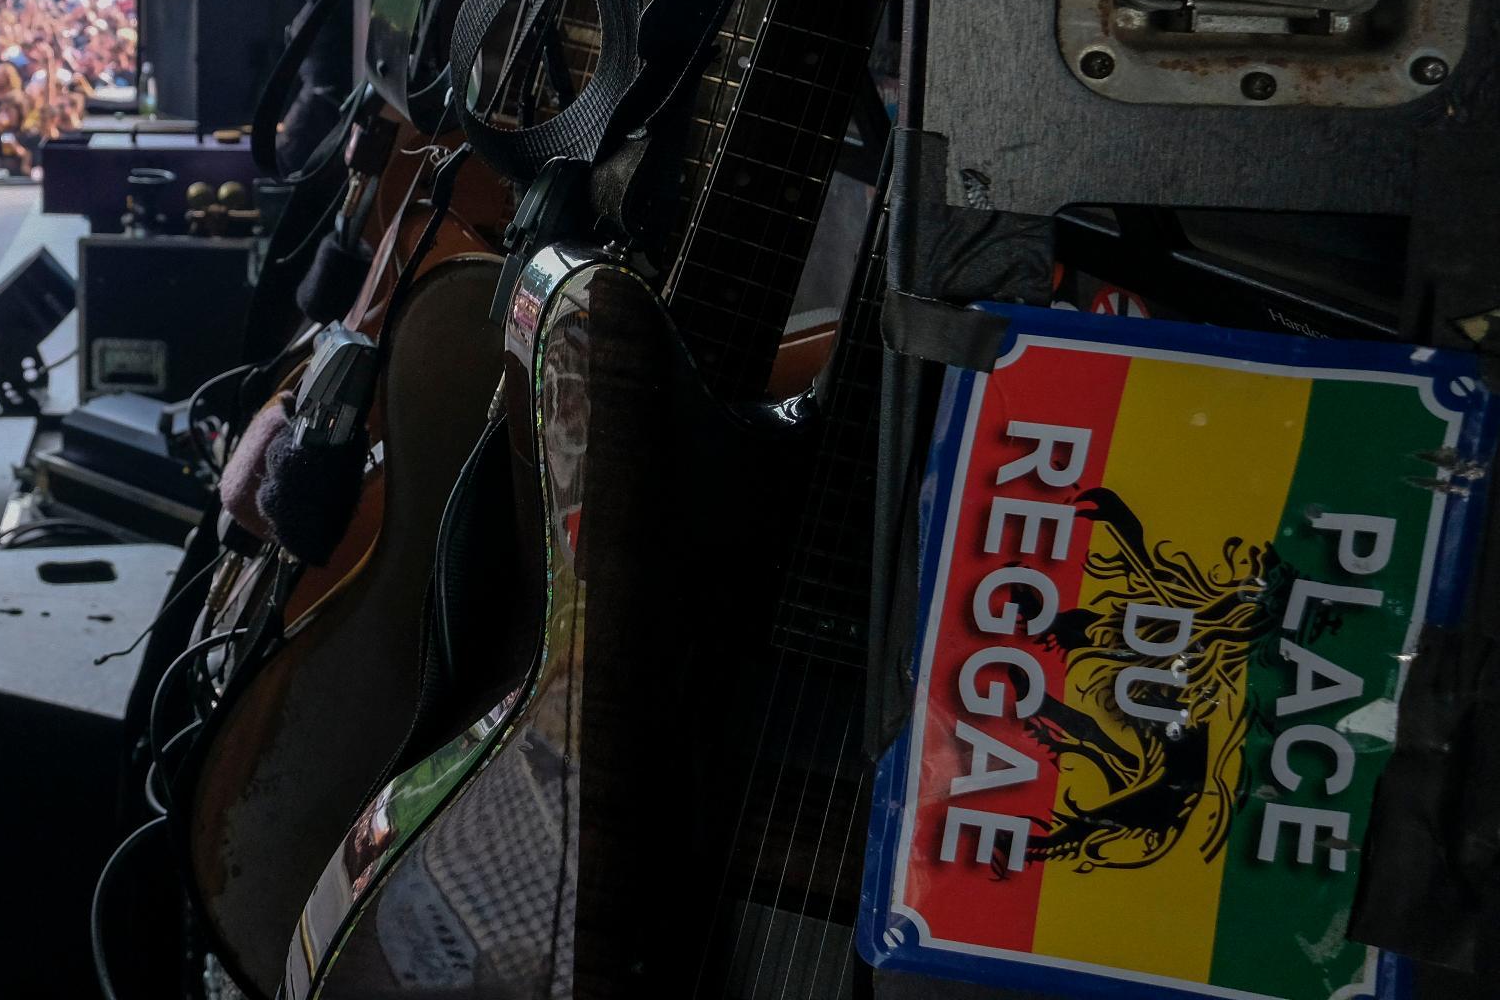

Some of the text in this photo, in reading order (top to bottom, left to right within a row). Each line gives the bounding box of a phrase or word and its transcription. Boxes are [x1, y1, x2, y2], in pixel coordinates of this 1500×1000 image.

[939, 420, 1093, 874] REGGAE
[1113, 601, 1196, 727] DU
[1256, 510, 1398, 874] PLACE
